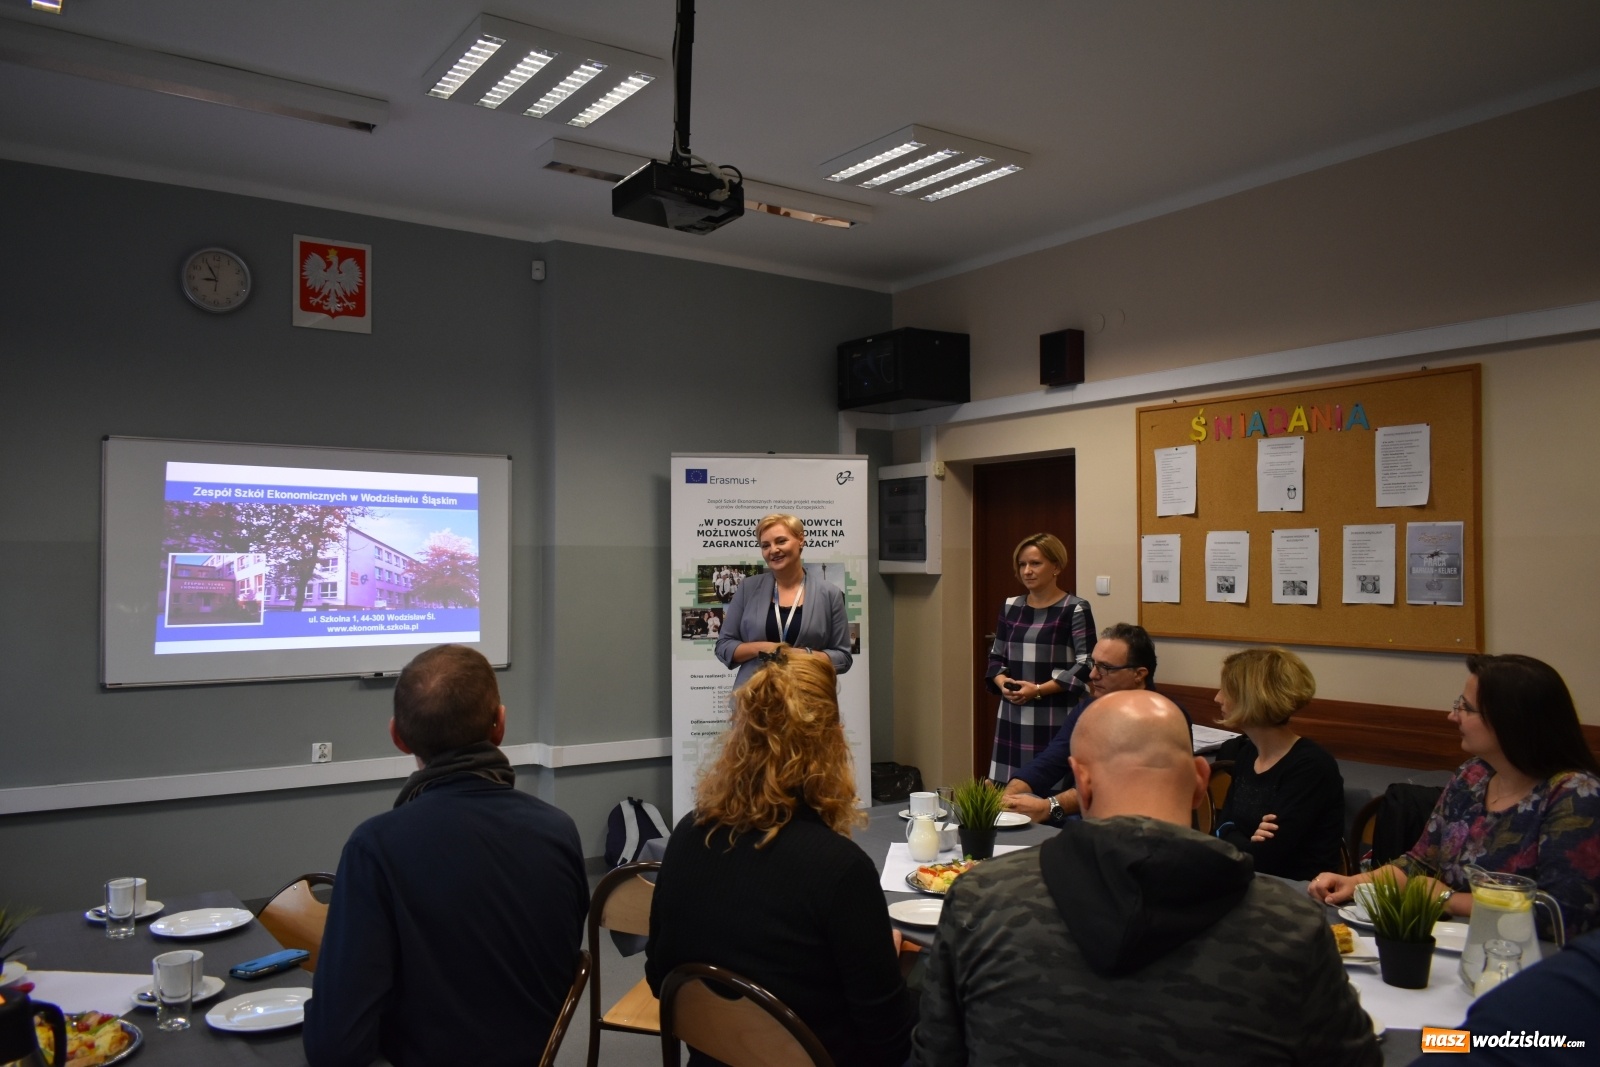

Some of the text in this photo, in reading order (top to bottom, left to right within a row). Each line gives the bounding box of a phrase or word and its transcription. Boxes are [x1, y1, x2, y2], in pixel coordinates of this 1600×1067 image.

[1189, 403, 1370, 442] ŚNIADANIA
[709, 475, 757, 485] Erasmus+
[192, 486, 458, 506] Zespół Szkół Ekonomicznych w Wodzisławiu Śląskim
[800, 518, 843, 527] NOWYCH
[803, 529, 828, 537] OMIK
[831, 529, 845, 537] NA
[702, 540, 760, 548] ZAGRANICZ
[319, 615, 351, 623] Szkolna
[352, 614, 359, 623] 1,
[360, 614, 385, 622] 44-300
[386, 613, 426, 621] Wodzisław
[426, 611, 436, 620] Śl.
[327, 623, 419, 633] www.ekonomik.szkola.pl
